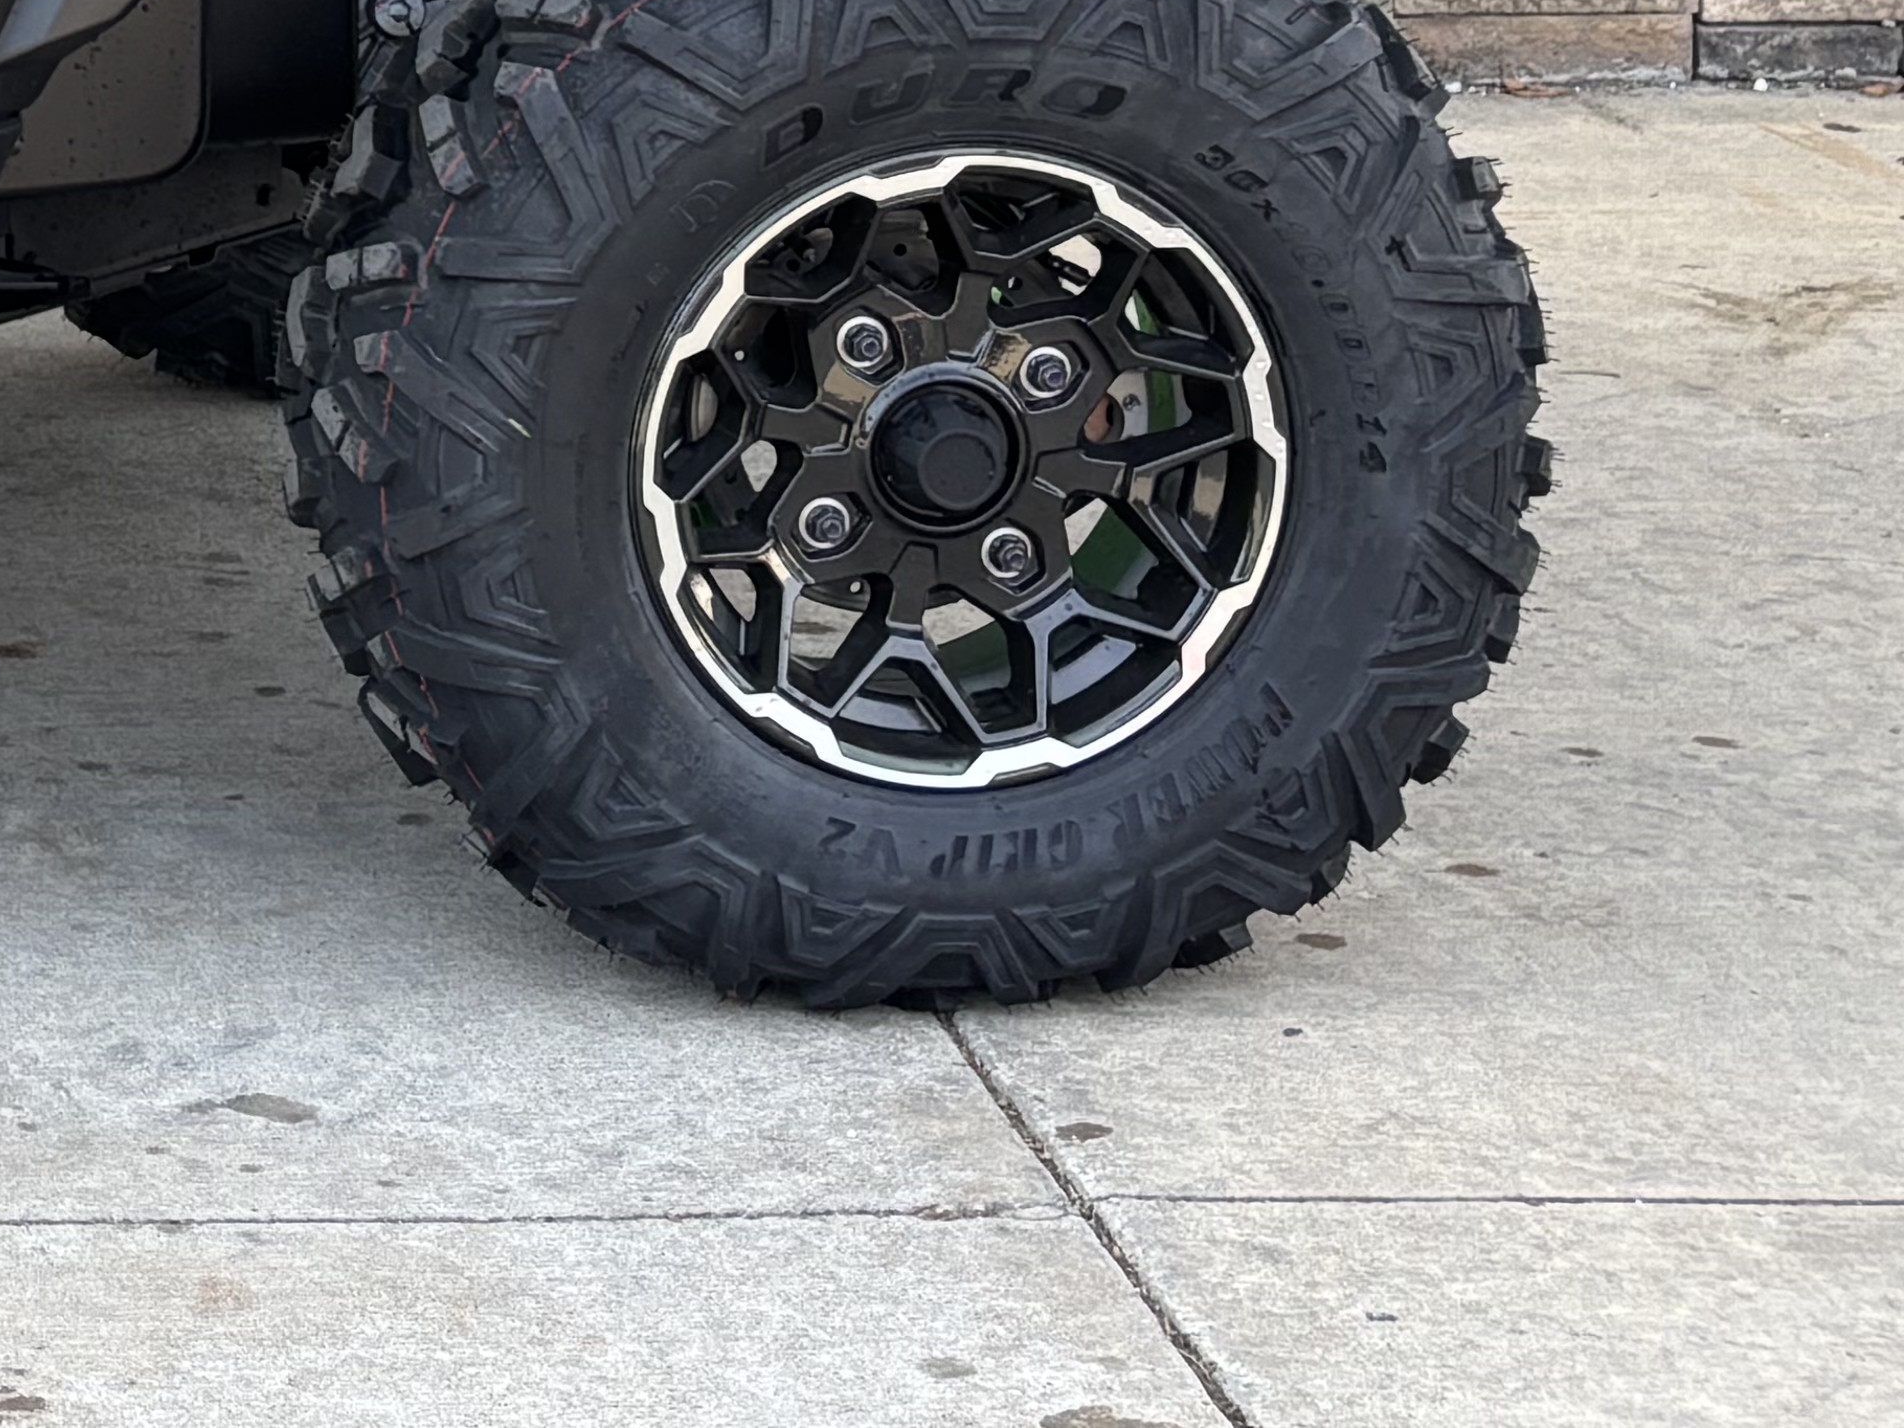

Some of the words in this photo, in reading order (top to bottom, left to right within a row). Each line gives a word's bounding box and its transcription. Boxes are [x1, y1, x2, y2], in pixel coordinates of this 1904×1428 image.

[763, 64, 1128, 168] DURO
[819, 815, 906, 883] V2
[930, 820, 1084, 879] GRIP
